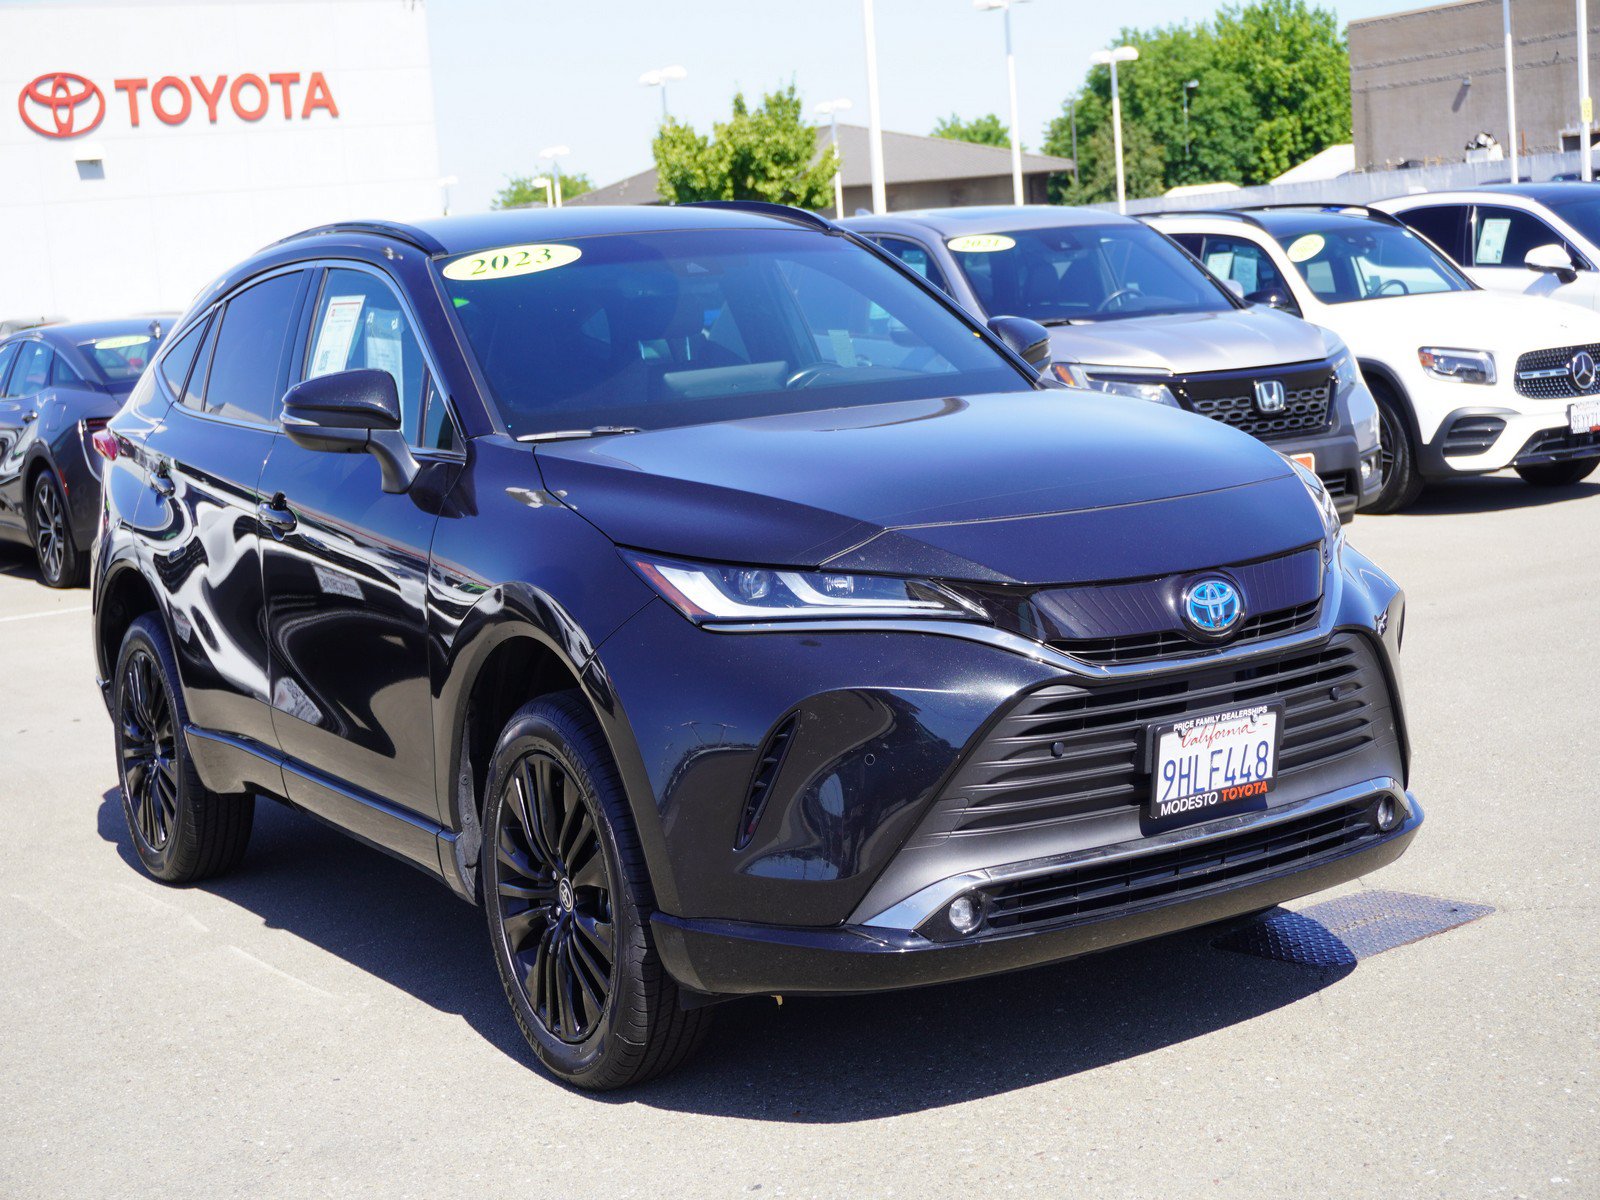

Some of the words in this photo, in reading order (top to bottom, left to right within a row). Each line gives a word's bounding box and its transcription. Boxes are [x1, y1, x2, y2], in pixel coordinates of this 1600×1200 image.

[114, 72, 340, 128] TOYOTA
[471, 248, 552, 275] 2023
[1174, 720, 1195, 732] PRICE
[1196, 715, 1221, 727] FAMILY
[1222, 706, 1268, 720] DEALERSHIPS
[1181, 722, 1257, 749] California
[1162, 740, 1270, 801] 9HLF448
[1160, 791, 1219, 817] MODESTO
[1221, 780, 1268, 802] TOYOTA
